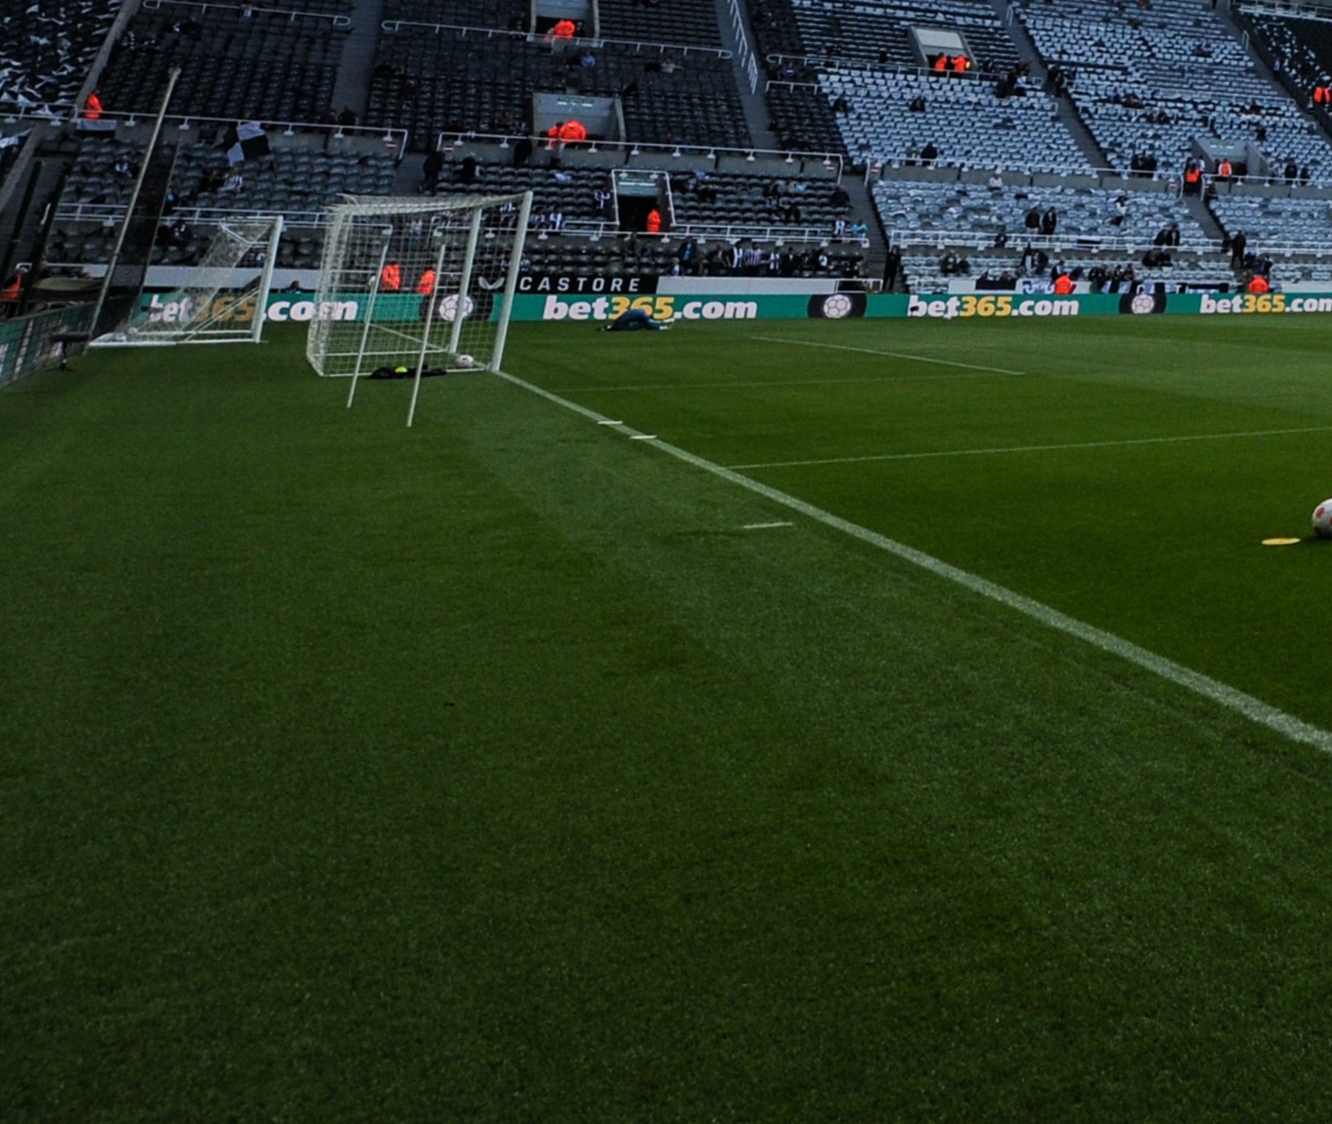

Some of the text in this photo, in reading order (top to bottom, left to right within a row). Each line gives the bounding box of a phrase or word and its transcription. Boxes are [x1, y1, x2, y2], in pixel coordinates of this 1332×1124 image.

[519, 276, 641, 293] CASTORE
[542, 294, 758, 321] bet365.com
[907, 295, 1080, 318] bet365.com
